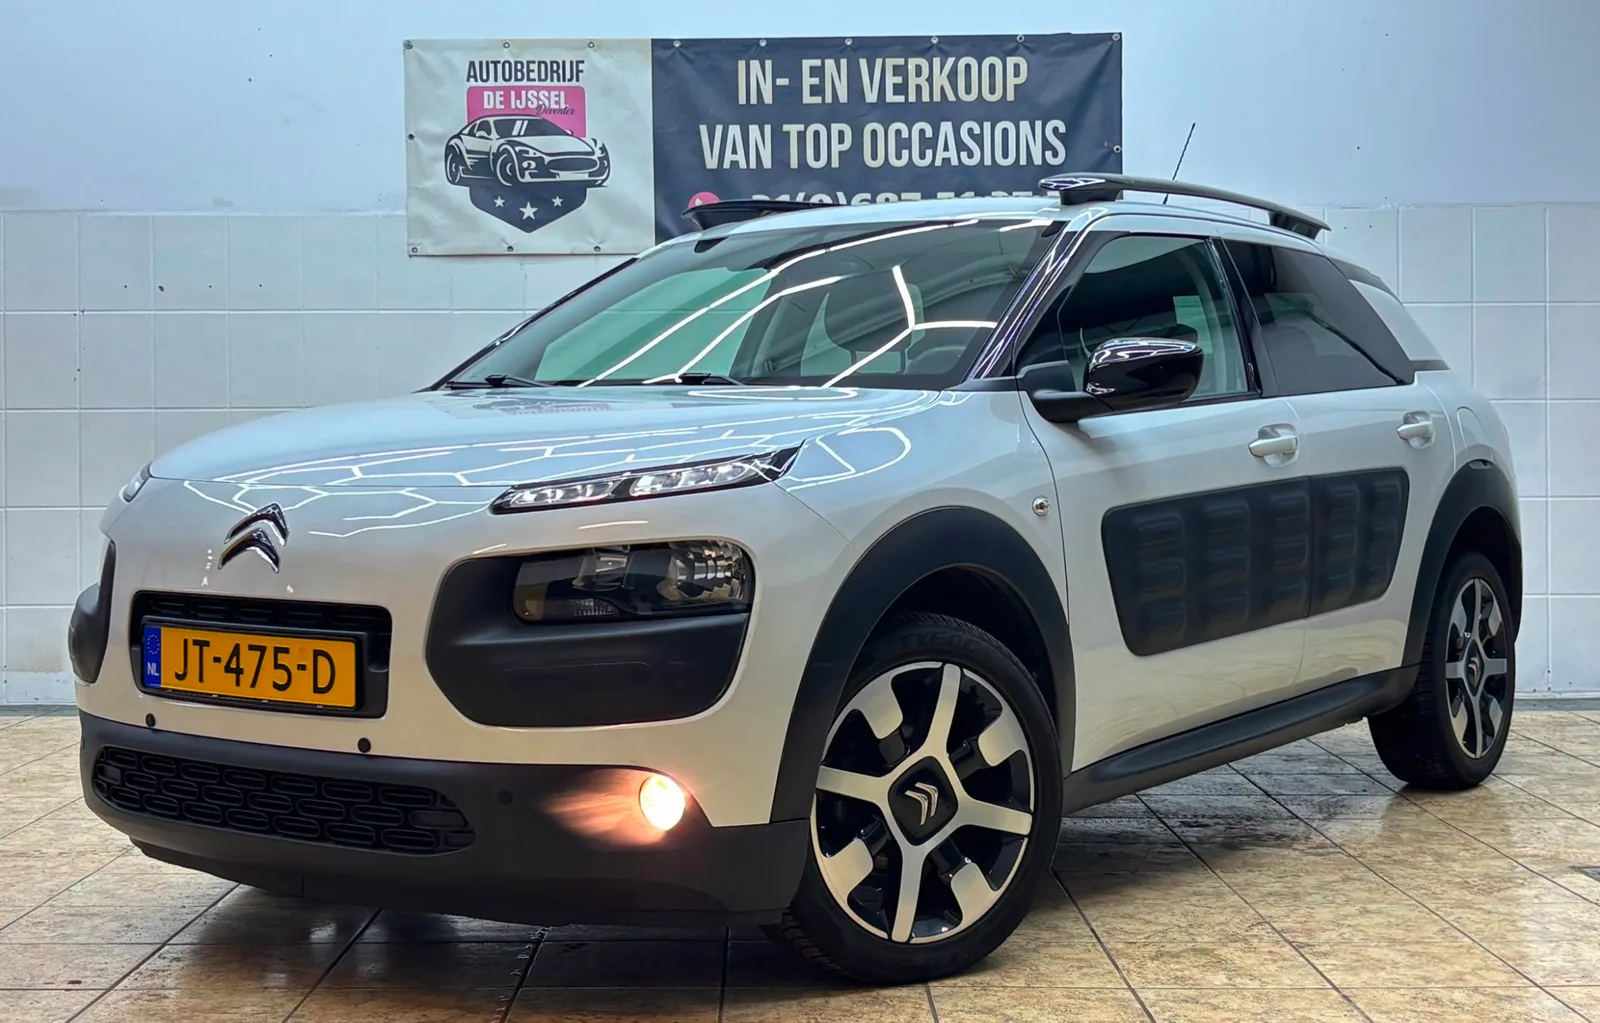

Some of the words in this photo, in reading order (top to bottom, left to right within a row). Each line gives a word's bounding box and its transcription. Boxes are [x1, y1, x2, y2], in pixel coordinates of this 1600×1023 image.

[466, 60, 585, 83] AUTOBEDRIJF
[737, 59, 790, 105] IN-
[801, 58, 848, 104] EN
[858, 56, 1029, 102] VERKOOP
[483, 91, 505, 109] DE
[510, 90, 569, 109] IJSSEL
[535, 104, 576, 116] Deventer
[699, 124, 773, 170] VAN
[782, 122, 853, 169] TOP
[863, 119, 1067, 168] OCCASIONS
[147, 661, 160, 677] NL
[174, 638, 337, 695] JT-475-D
